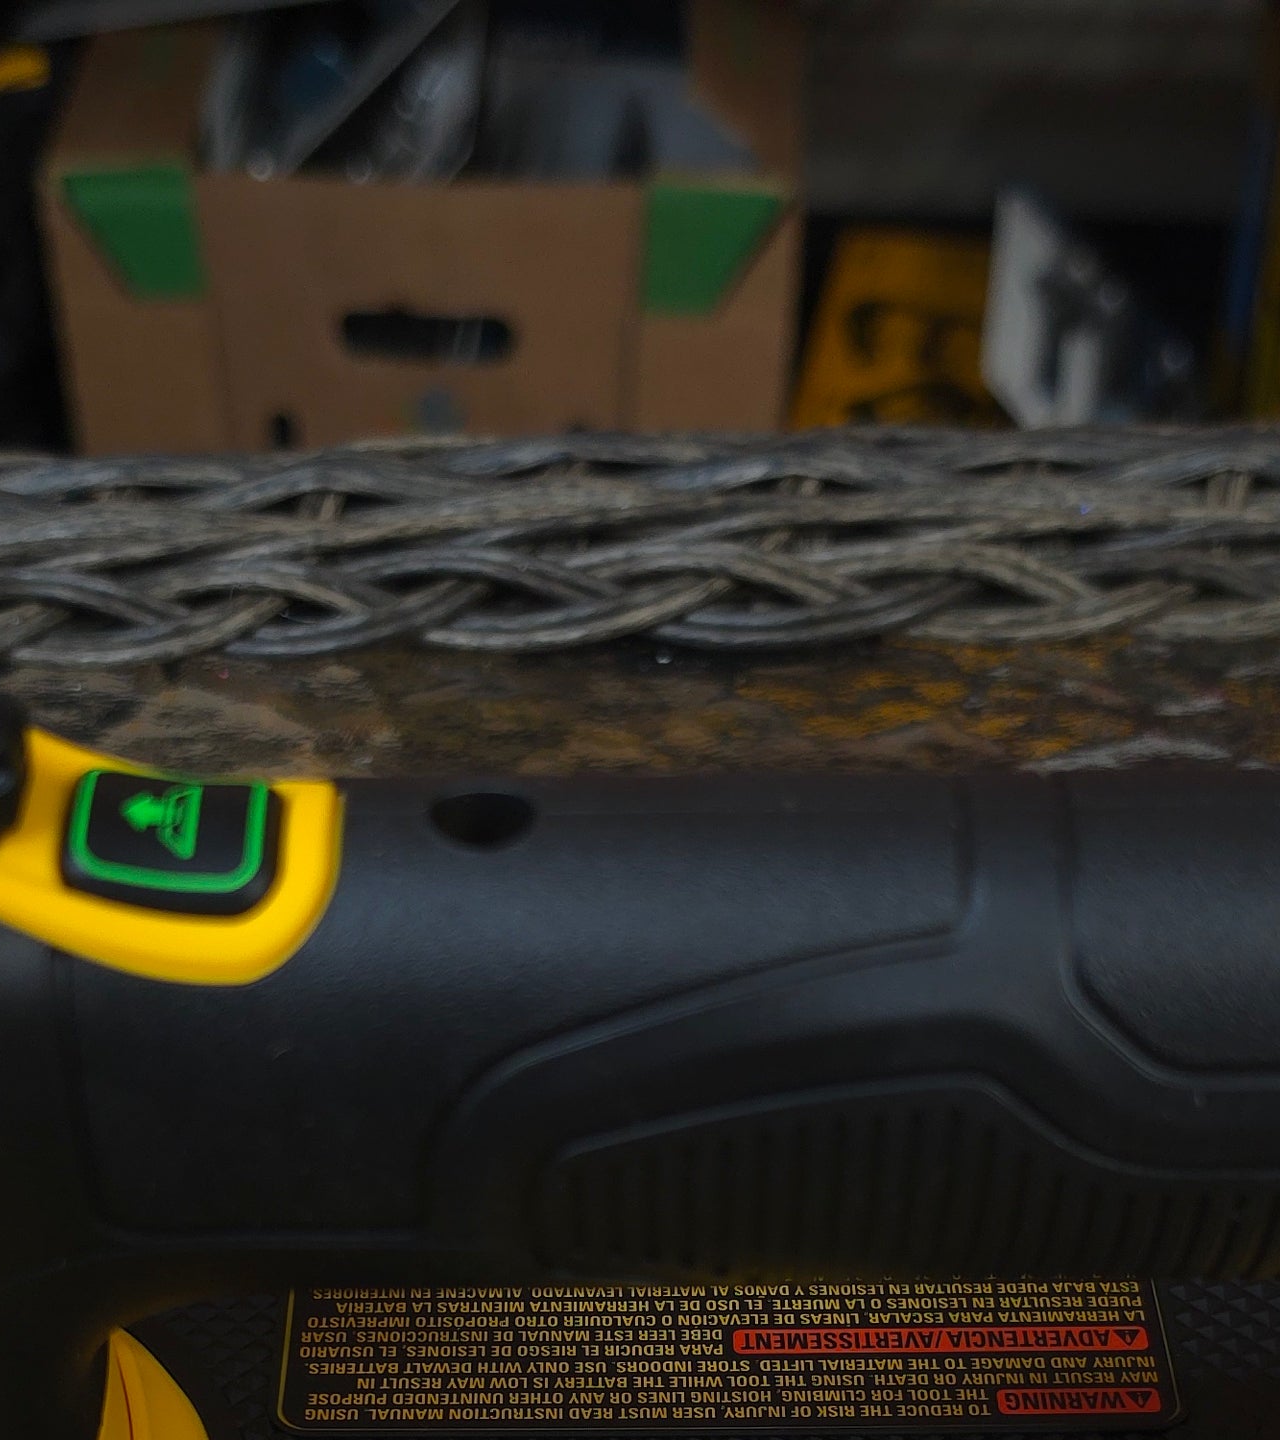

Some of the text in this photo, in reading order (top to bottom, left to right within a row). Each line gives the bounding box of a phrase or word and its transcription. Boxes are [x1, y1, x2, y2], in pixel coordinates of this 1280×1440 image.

[412, 1301, 431, 1314] LA
[438, 1300, 524, 1314] MIENTRAS
[530, 1299, 649, 1313] HERRAMIENTA
[655, 1299, 674, 1312] LA
[680, 1299, 700, 1312] DE
[706, 1299, 739, 1312] USO
[744, 1298, 762, 1312] EL
[845, 1298, 864, 1311] LA
[871, 1297, 881, 1310] O
[887, 1296, 967, 1310] LESIONES
[973, 1296, 994, 1309] EN
[999, 1295, 1082, 1309] RESULTAR
[1087, 1295, 1141, 1308] PUEDE
[515, 1315, 557, 1328] OTRO
[564, 1314, 655, 1328] CUALQUIER
[662, 1314, 672, 1327] O
[774, 1313, 794, 1326] DE
[949, 1310, 993, 1324] PARA
[998, 1309, 1119, 1323] HERRAMIENTA
[1124, 1308, 1145, 1322] LA
[308, 1316, 409, 1329] IMPREVISTO
[302, 1330, 346, 1343] USAR
[494, 1329, 513, 1342] DE
[519, 1329, 589, 1342] MANUAL
[596, 1329, 632, 1342] ESTE
[639, 1328, 675, 1342] LEER
[681, 1328, 722, 1341] DEBE
[300, 1345, 373, 1358] USUARIO
[379, 1345, 396, 1358] EL
[491, 1344, 511, 1357] DE
[518, 1344, 576, 1357] RIESGO
[582, 1344, 599, 1357] EL
[605, 1343, 674, 1357] REDUCIR
[680, 1343, 723, 1356] PARA
[404, 1361, 471, 1375] DEWALT
[478, 1361, 522, 1374] WITH
[527, 1361, 569, 1374] ONLY
[575, 1360, 606, 1373] USE
[698, 1359, 749, 1373] STORE
[818, 1358, 902, 1371] MATERIAL
[908, 1357, 940, 1371] THE
[945, 1357, 966, 1370] TO
[971, 1356, 1045, 1370] DAMAGE
[1051, 1355, 1086, 1369] AND
[1094, 1355, 1154, 1368] INJURY
[357, 1377, 375, 1390] IN
[380, 1377, 441, 1390] RESULT
[447, 1376, 484, 1390] MAY
[490, 1376, 527, 1389] LOW
[534, 1376, 548, 1389] IS
[554, 1375, 627, 1389] BATTERY
[633, 1375, 664, 1388] THE
[669, 1375, 722, 1388] WHILE
[727, 1374, 770, 1388] TOOL
[775, 1374, 806, 1387] THE
[812, 1374, 864, 1387] USING
[934, 1373, 956, 1386] OR
[963, 1372, 1024, 1386] INJURY
[1030, 1372, 1047, 1385] IN
[1053, 1371, 1114, 1385] RESULT
[1121, 1371, 1158, 1384] MAY
[309, 1392, 386, 1405] PURPOSE
[393, 1392, 503, 1405] UNINTENDED
[510, 1392, 563, 1405] OTHER
[569, 1391, 604, 1405] ANY
[610, 1391, 631, 1404] OR
[638, 1391, 684, 1404] LINES
[691, 1390, 771, 1404] HOISTING
[871, 1389, 902, 1402] FOR
[907, 1388, 952, 1402] TOOL
[956, 1387, 988, 1401] THE
[1004, 1391, 1126, 1410] WARNING
[305, 1408, 358, 1421] USING
[449, 1407, 562, 1421] INSTRUCTION
[569, 1407, 612, 1420] READ
[618, 1407, 667, 1420] MUST
[673, 1406, 715, 1419] USER
[791, 1405, 811, 1418] OF
[817, 1405, 854, 1418] RISK
[860, 1404, 892, 1418] THE
[897, 1403, 963, 1417] REDUCE
[969, 1403, 991, 1416] TO
